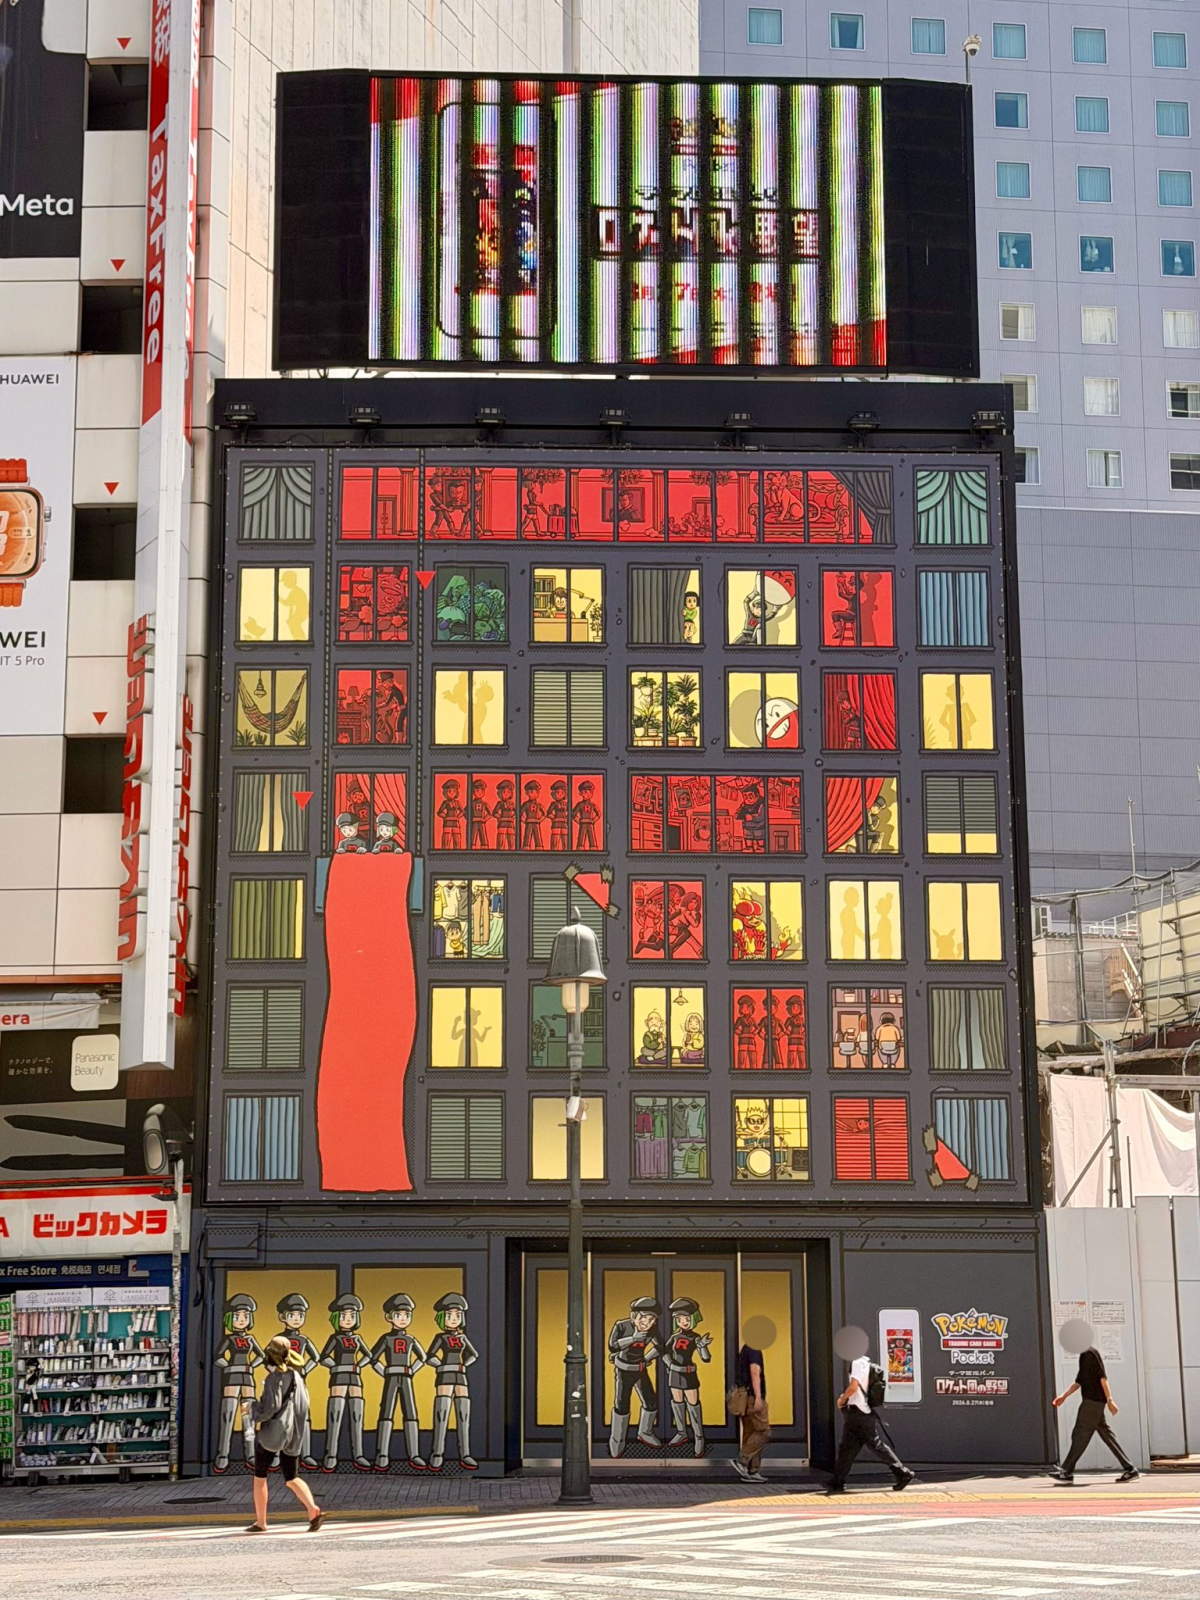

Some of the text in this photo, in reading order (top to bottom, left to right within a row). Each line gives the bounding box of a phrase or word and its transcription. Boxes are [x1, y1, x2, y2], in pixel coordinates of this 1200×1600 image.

[0, 194, 74, 216] Meta
[147, 103, 169, 364] TaxFree
[0, 373, 59, 385] HUAWEI
[15, 655, 22, 666] 5
[26, 655, 45, 666] Pro
[1, 1014, 30, 1026] era
[75, 1053, 116, 1063] Panasonic
[74, 1066, 104, 1077] Beauty
[33, 1209, 168, 1239] ビックカメラ
[7, 1266, 29, 1276] Free
[30, 1265, 57, 1276] Store
[61, 1265, 93, 1275] 免税商店
[951, 1350, 995, 1364] Pocket
[936, 1379, 1009, 1394] ロケット団の野望
